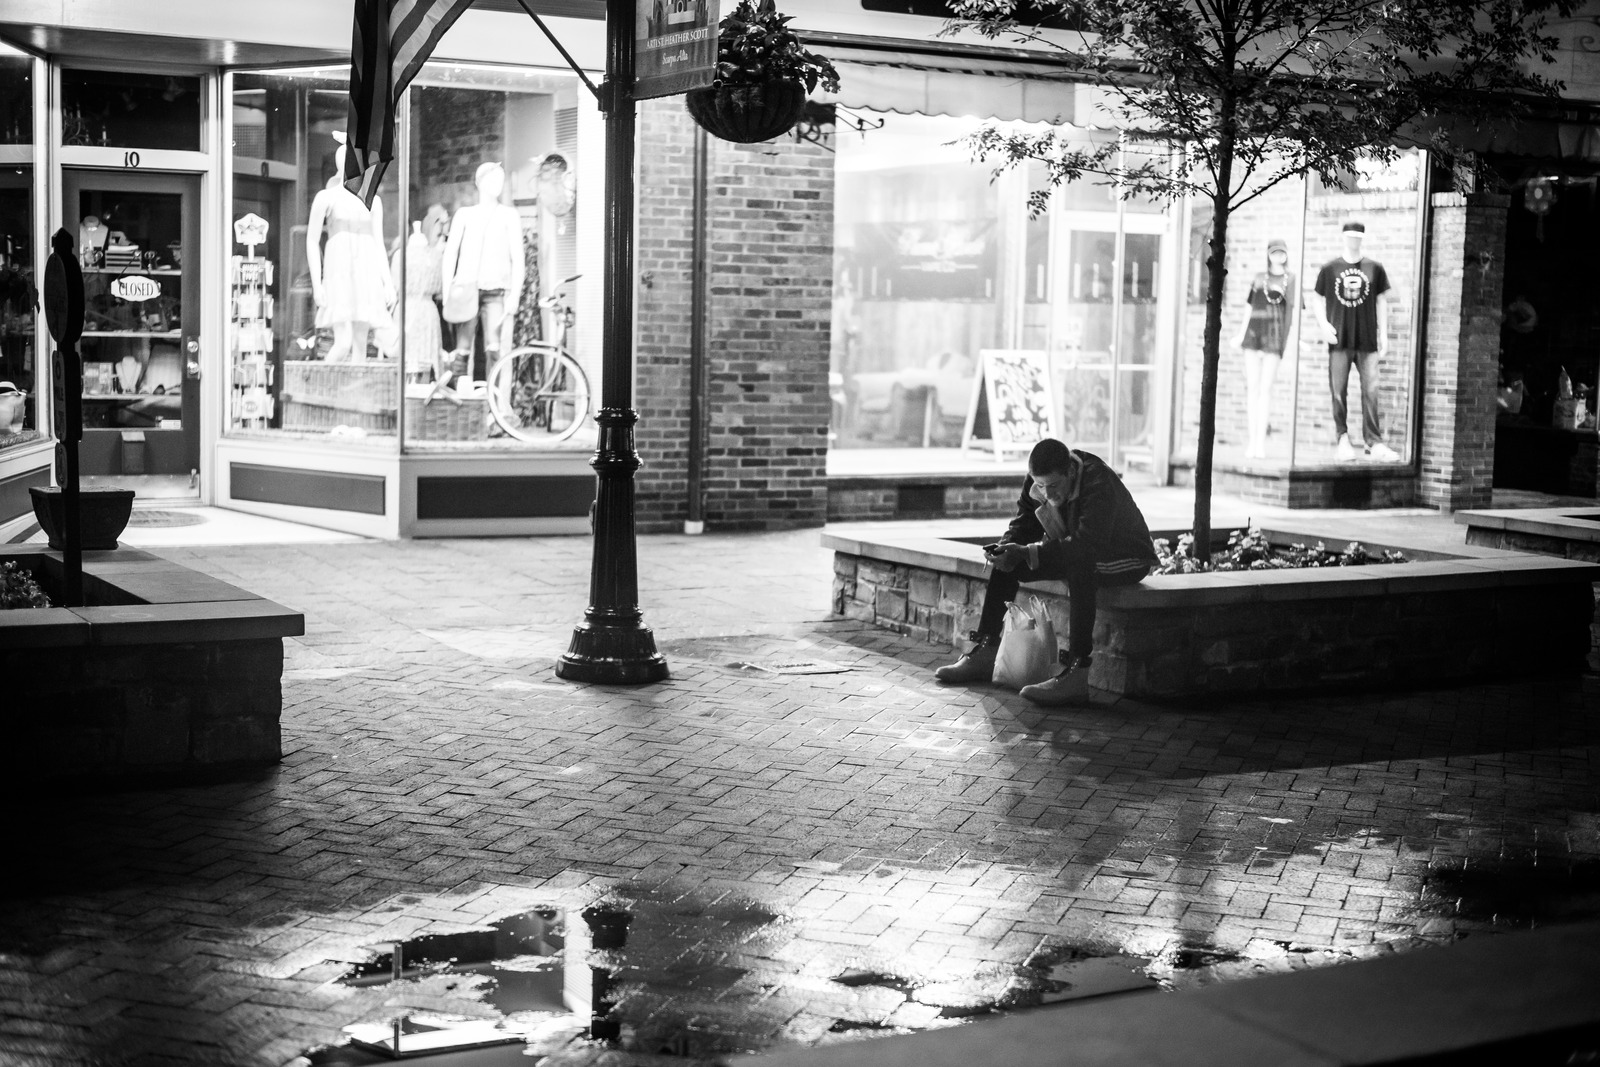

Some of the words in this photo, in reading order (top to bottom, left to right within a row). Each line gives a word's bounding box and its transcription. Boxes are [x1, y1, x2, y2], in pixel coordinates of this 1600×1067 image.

[665, 32, 689, 46] HEATHER
[690, 28, 708, 40] SCOTT
[124, 151, 140, 167] 10
[118, 284, 154, 296] CLOSED
